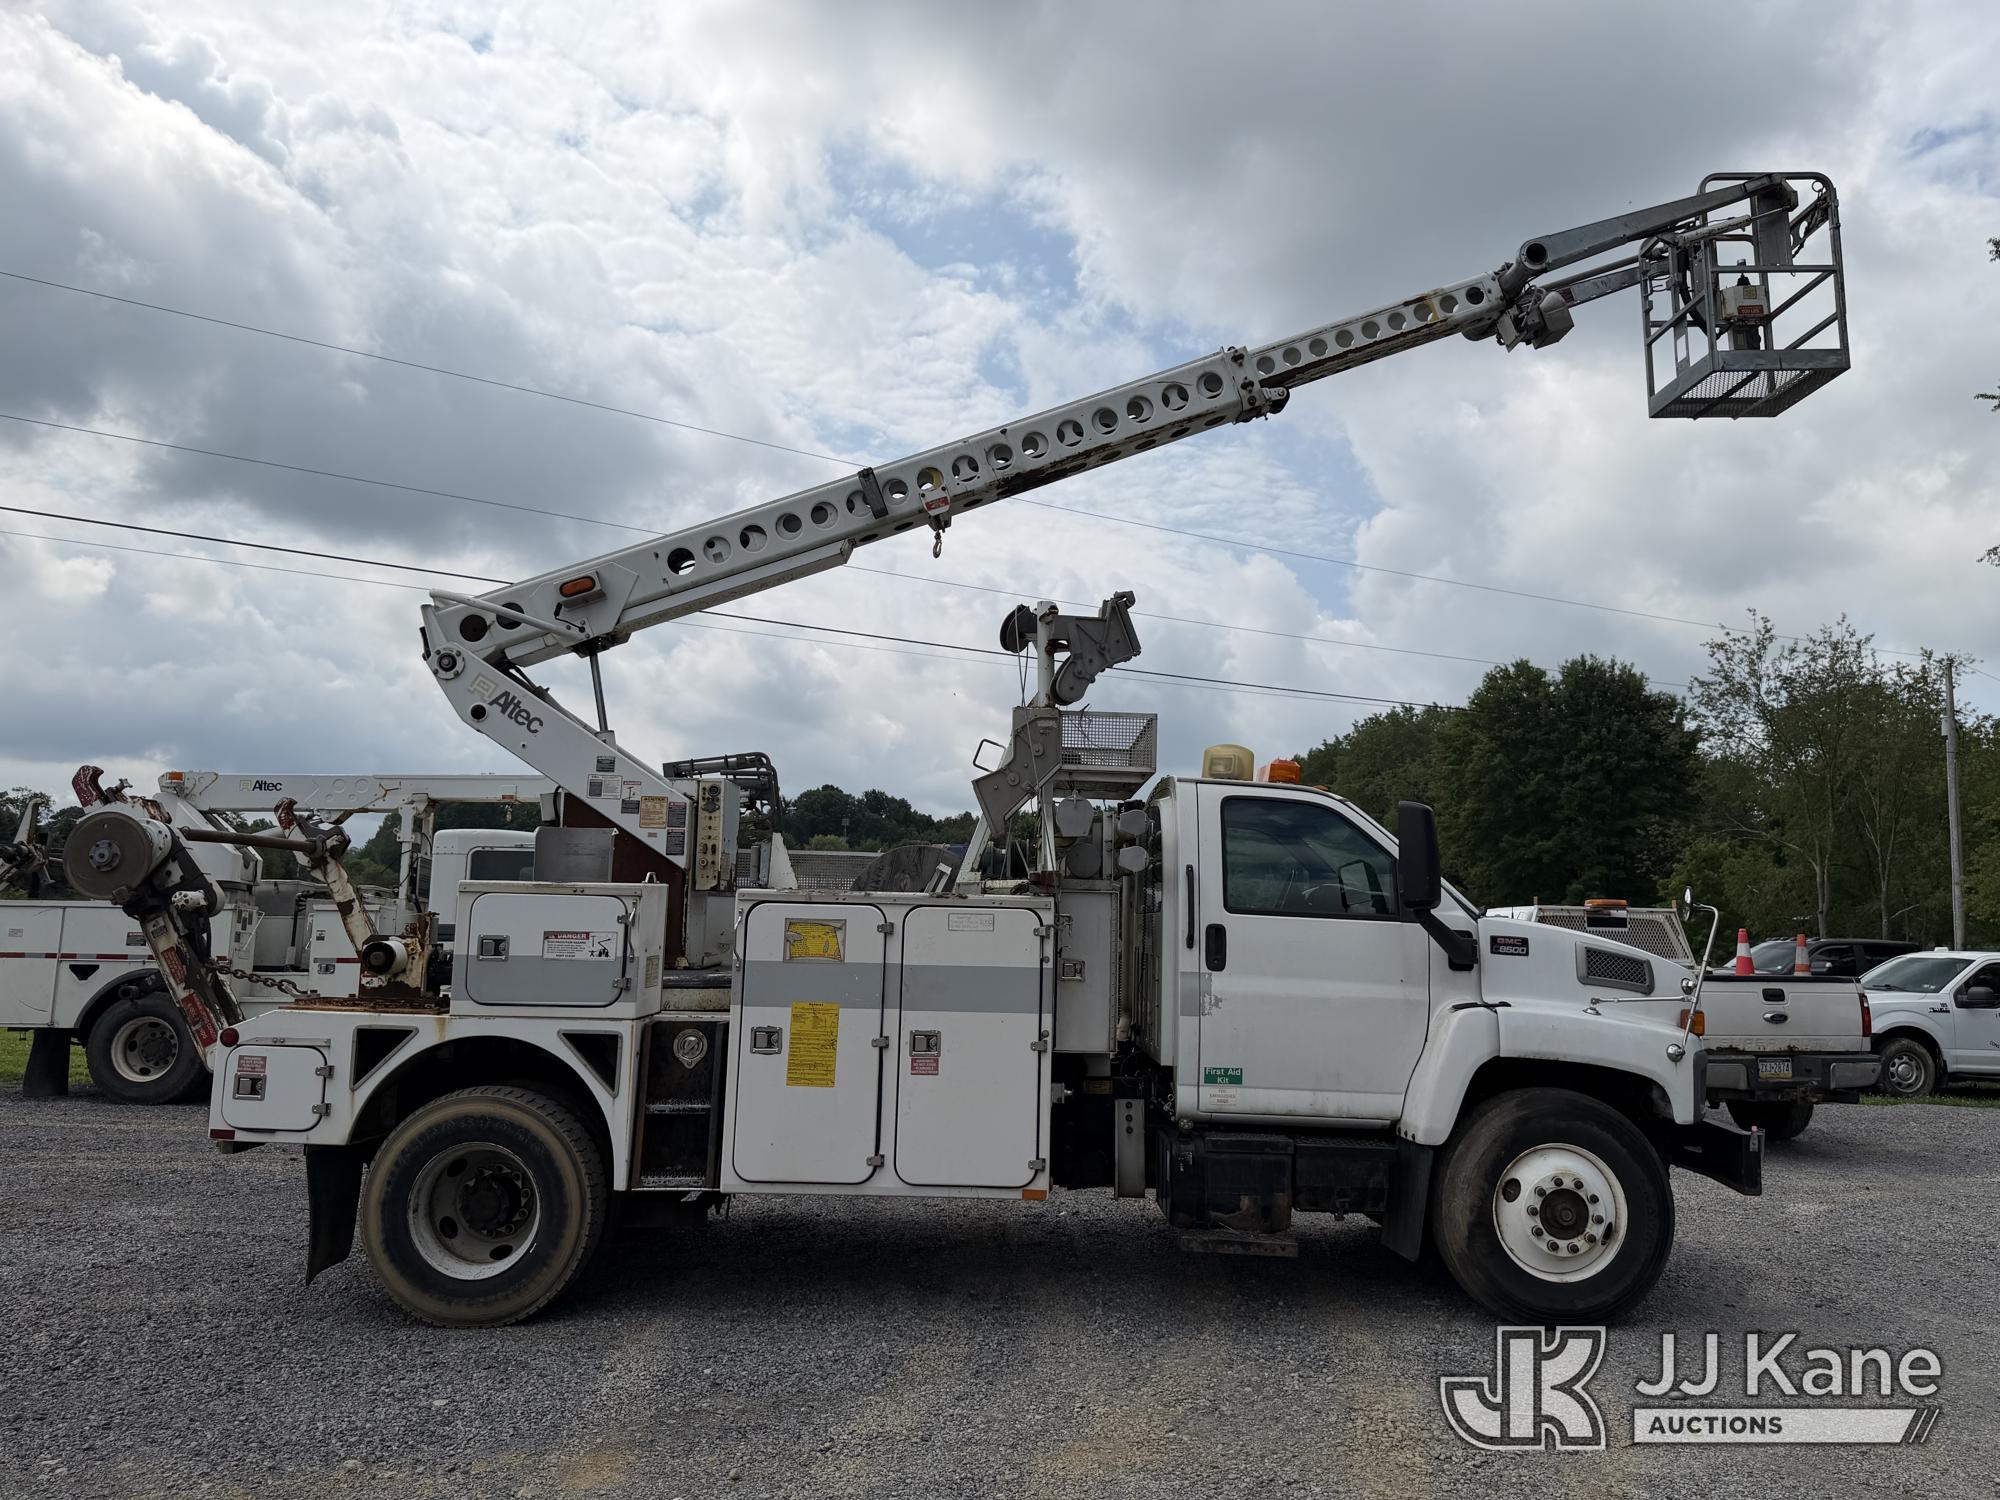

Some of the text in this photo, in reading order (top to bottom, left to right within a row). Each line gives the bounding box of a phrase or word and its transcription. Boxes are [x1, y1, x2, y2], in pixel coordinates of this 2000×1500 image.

[487, 690, 544, 734] Altec
[252, 780, 282, 791] Altec
[557, 932, 587, 940] DANGER
[1217, 1076, 1229, 1084] Kit
